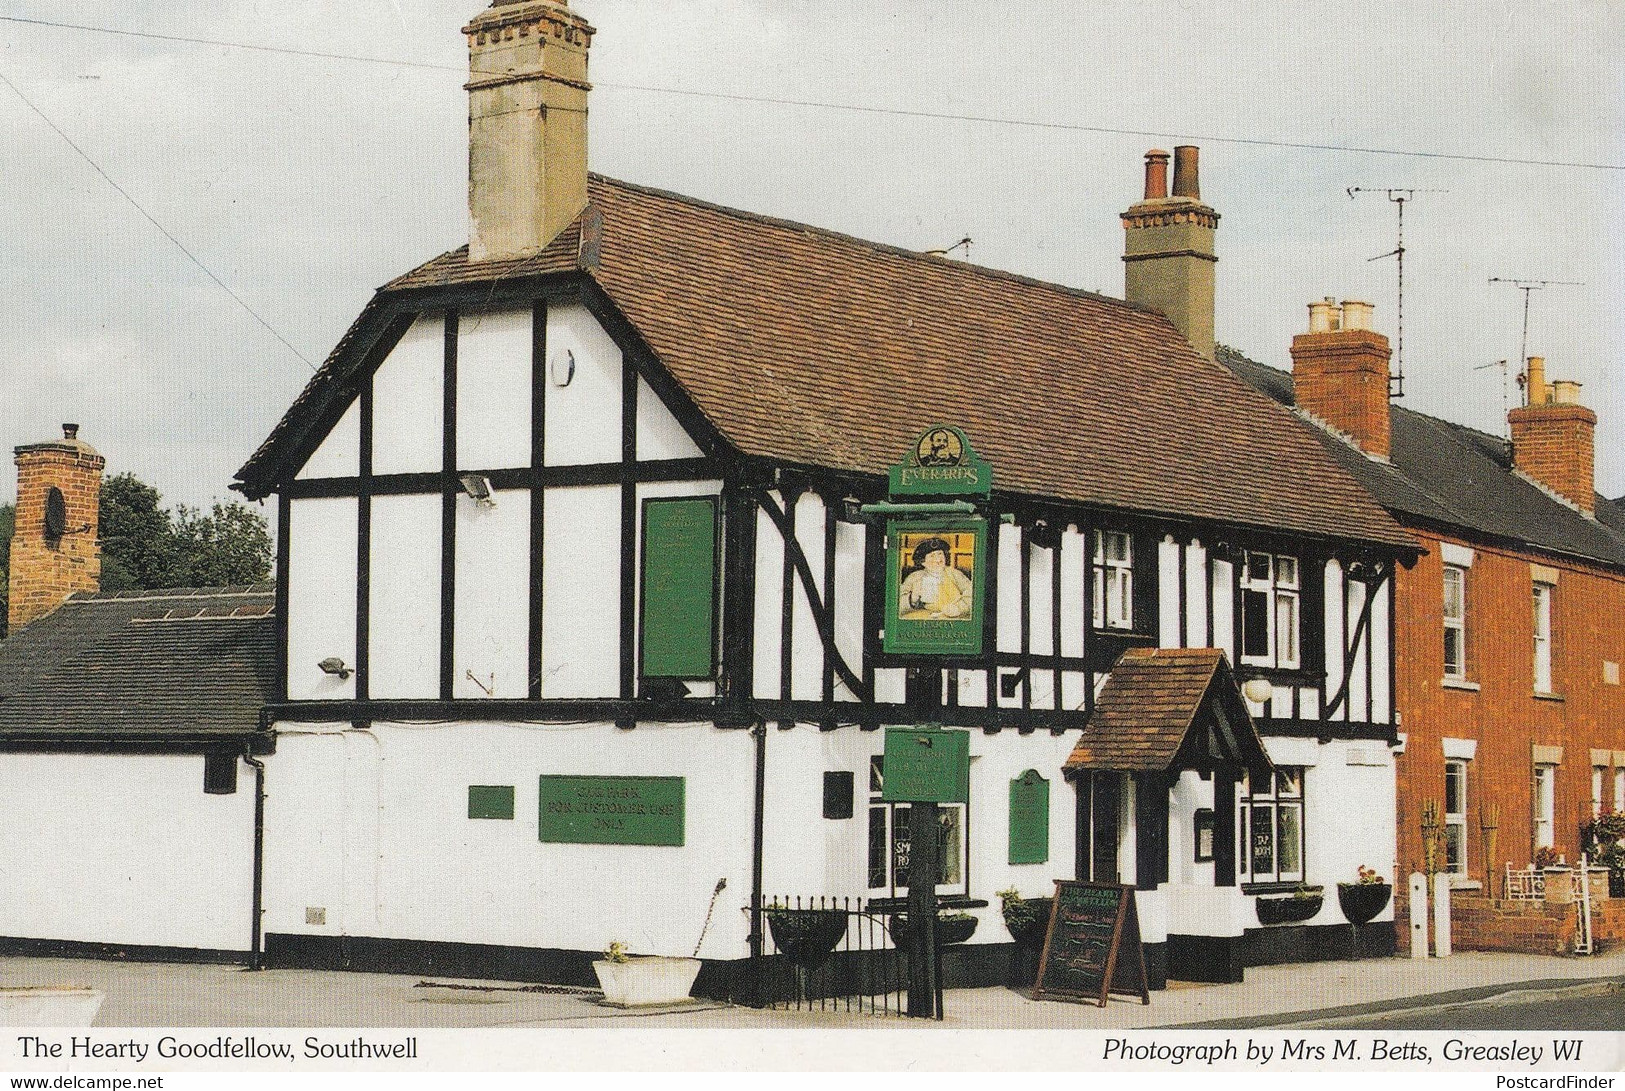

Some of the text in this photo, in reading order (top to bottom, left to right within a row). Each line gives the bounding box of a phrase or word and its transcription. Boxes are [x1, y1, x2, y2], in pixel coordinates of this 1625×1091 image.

[901, 467, 979, 486] EVERARDS
[606, 788, 641, 799] PARK
[547, 802, 675, 816] FOR CUSTOMER USE
[592, 818, 625, 830] ONLY
